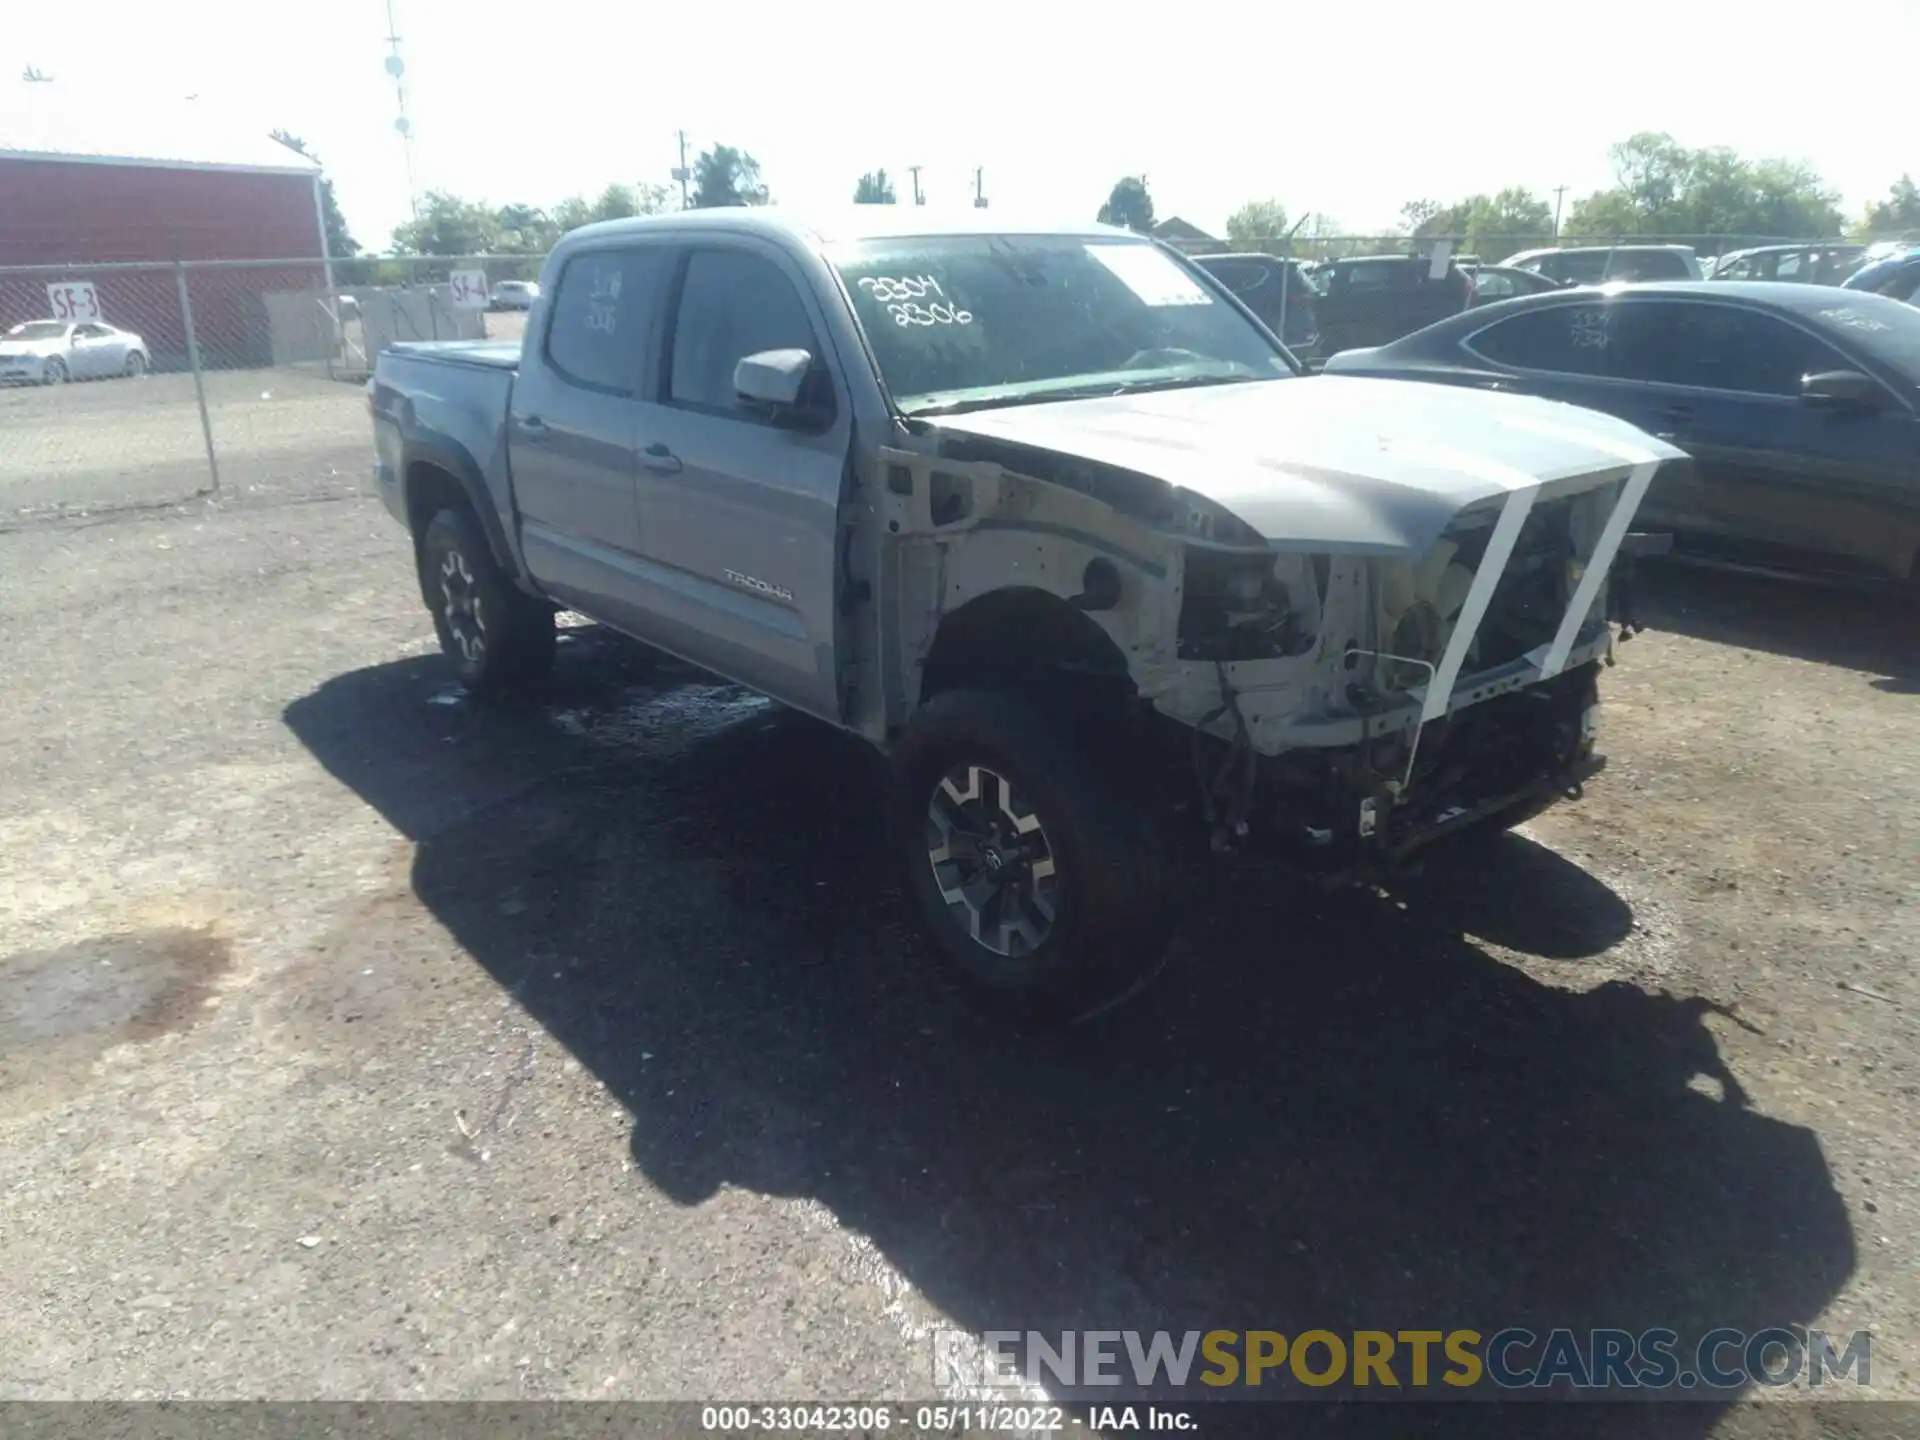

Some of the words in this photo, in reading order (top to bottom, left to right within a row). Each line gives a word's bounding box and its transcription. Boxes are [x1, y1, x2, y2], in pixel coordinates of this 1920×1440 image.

[452, 273, 487, 302] SF-4
[857, 274, 944, 301] 3304
[53, 287, 98, 318] SF-3
[886, 300, 973, 328] 2306
[723, 567, 794, 601] TACOMA
